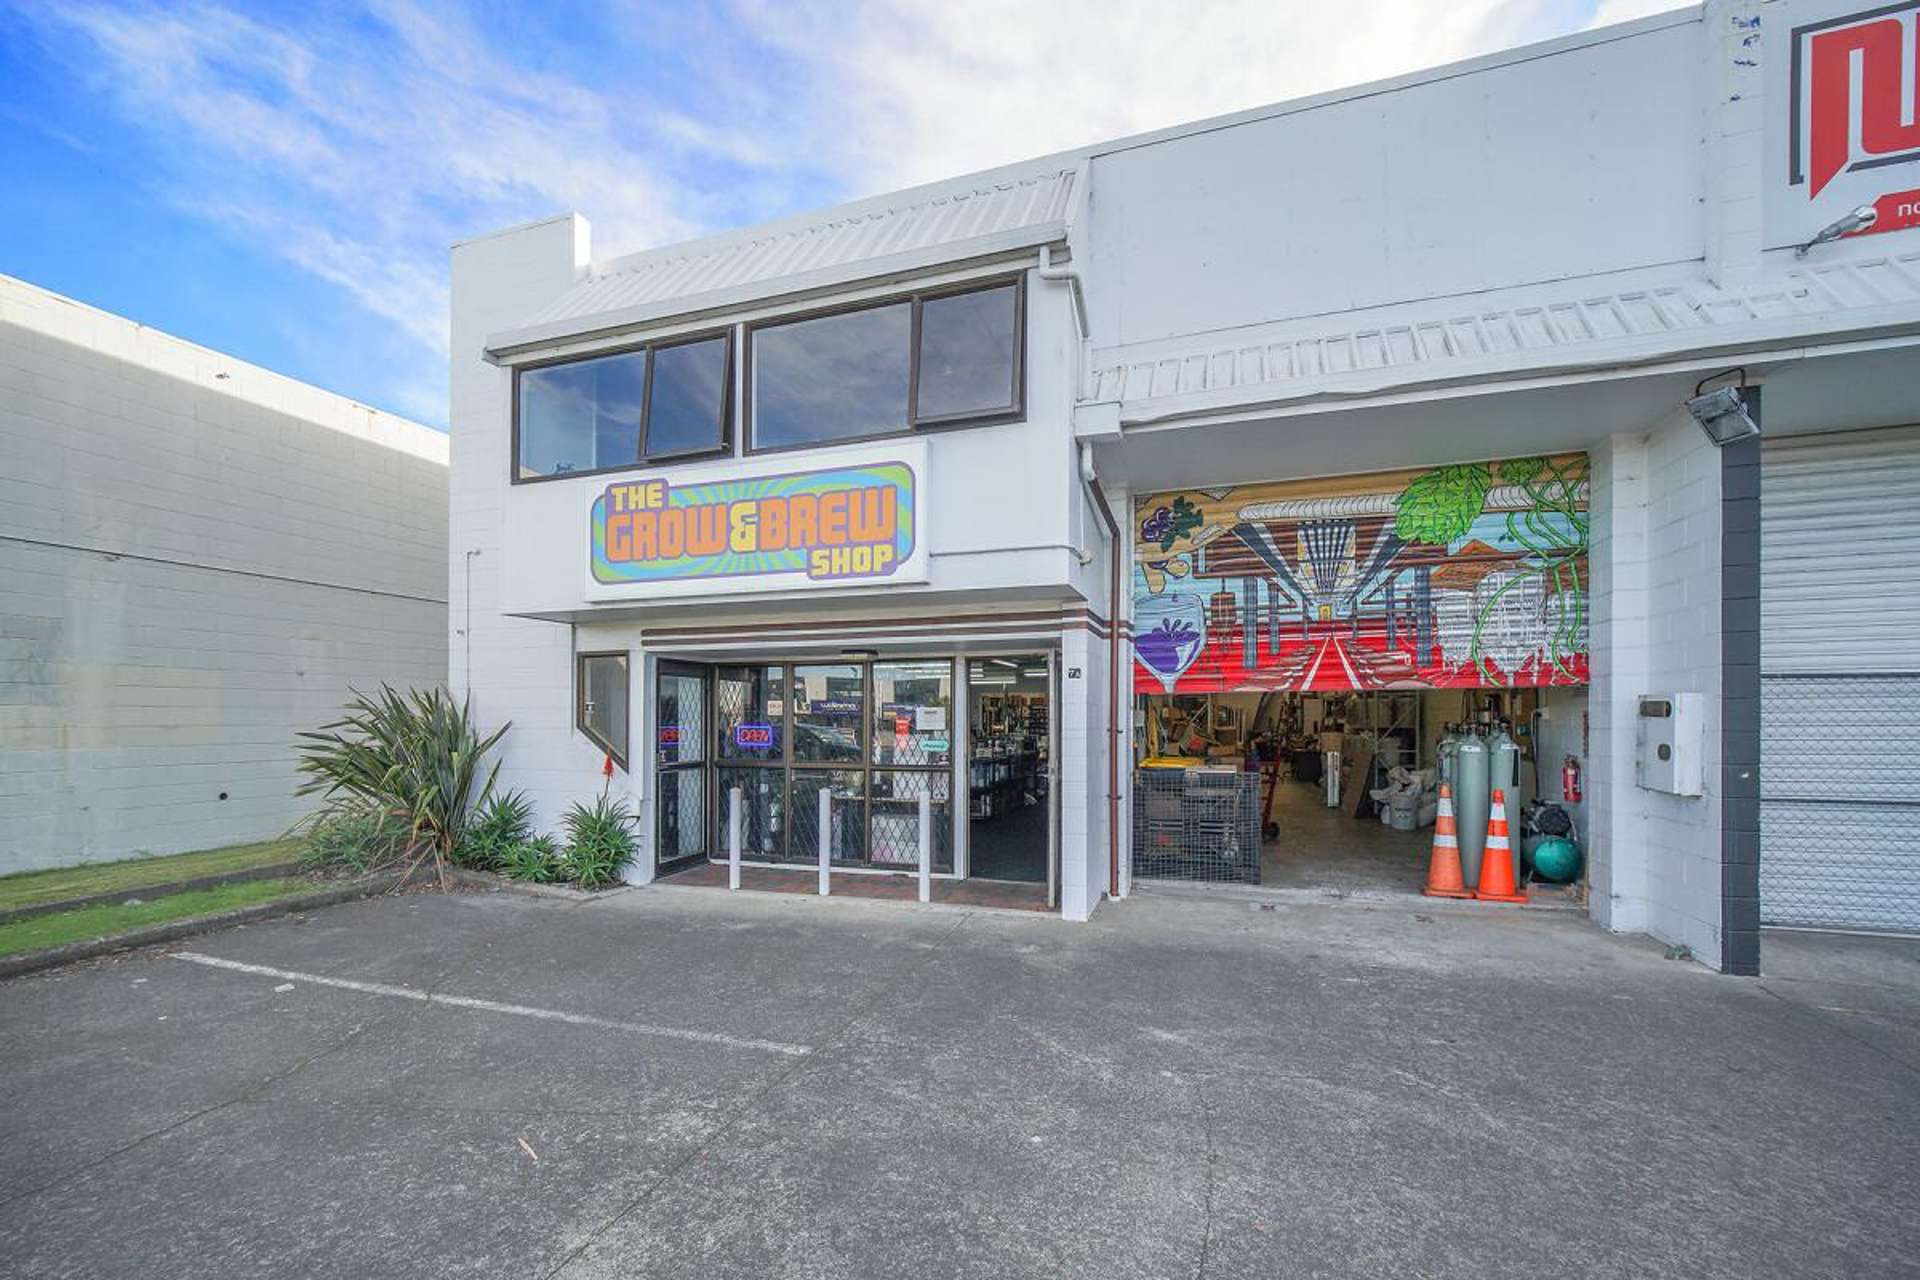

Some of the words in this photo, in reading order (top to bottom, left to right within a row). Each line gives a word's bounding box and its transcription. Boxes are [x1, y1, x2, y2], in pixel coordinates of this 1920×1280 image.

[611, 483, 662, 512] THE
[811, 544, 893, 576] SHOP
[740, 729, 769, 742] OPEN
